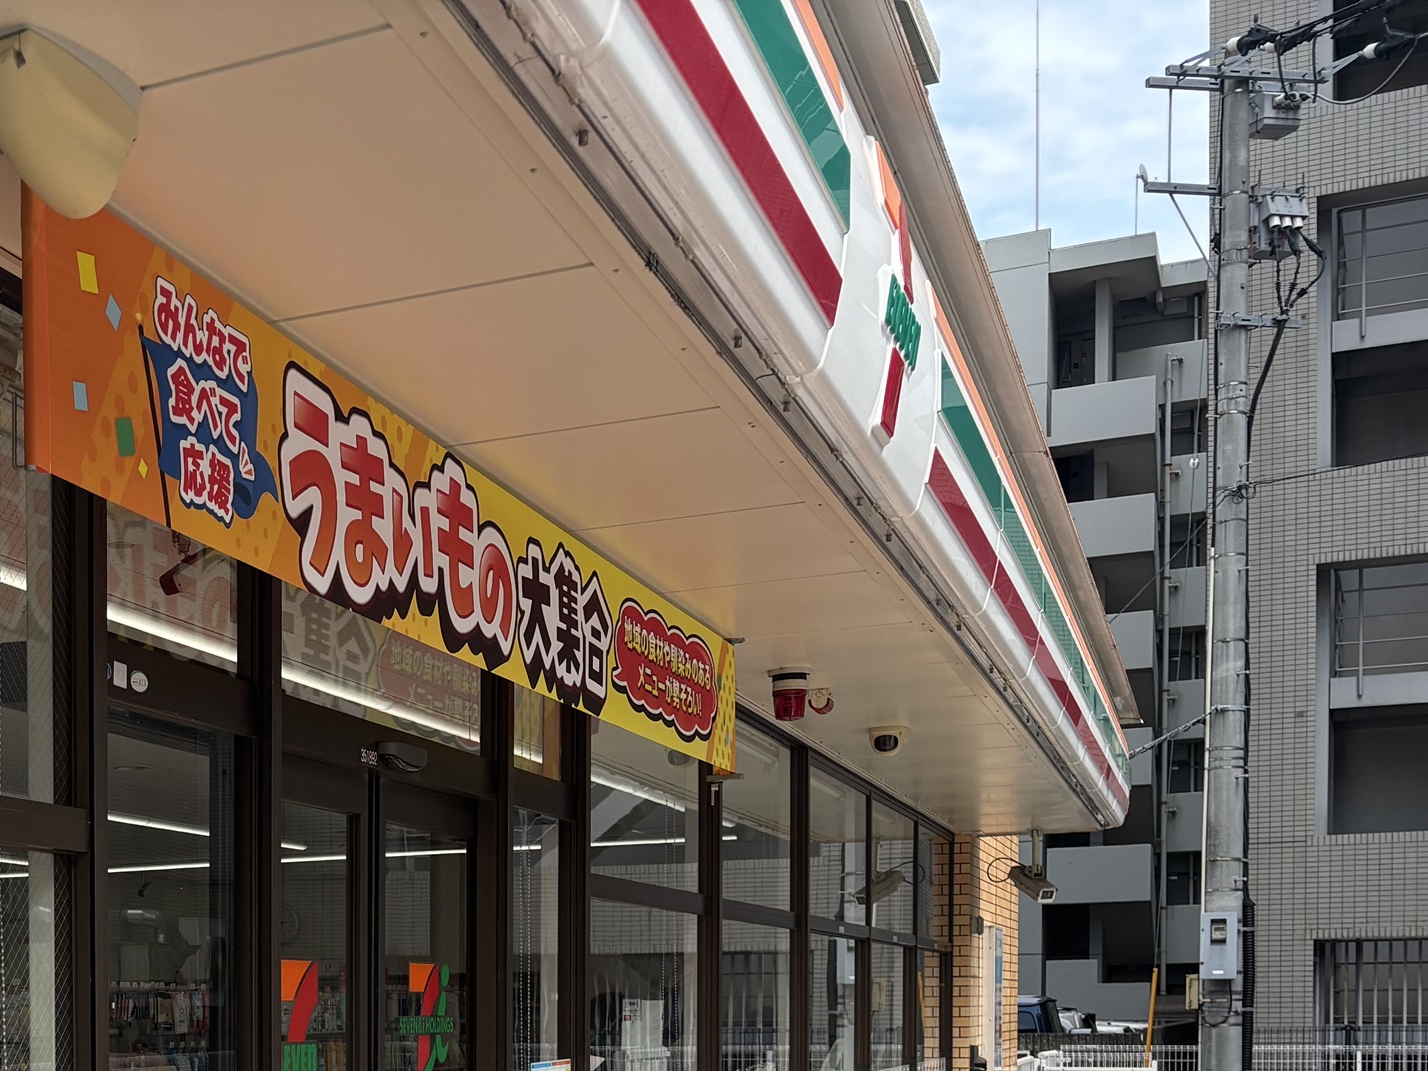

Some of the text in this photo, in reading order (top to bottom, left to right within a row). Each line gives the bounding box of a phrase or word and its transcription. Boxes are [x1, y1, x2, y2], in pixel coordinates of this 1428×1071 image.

[155, 276, 251, 388] みんなで
[168, 361, 241, 453] 食べて
[179, 438, 234, 523] 応援
[282, 362, 515, 658] うまいもの
[518, 539, 612, 698] 大集合
[624, 615, 712, 690] 地域の食材や馴染みのある
